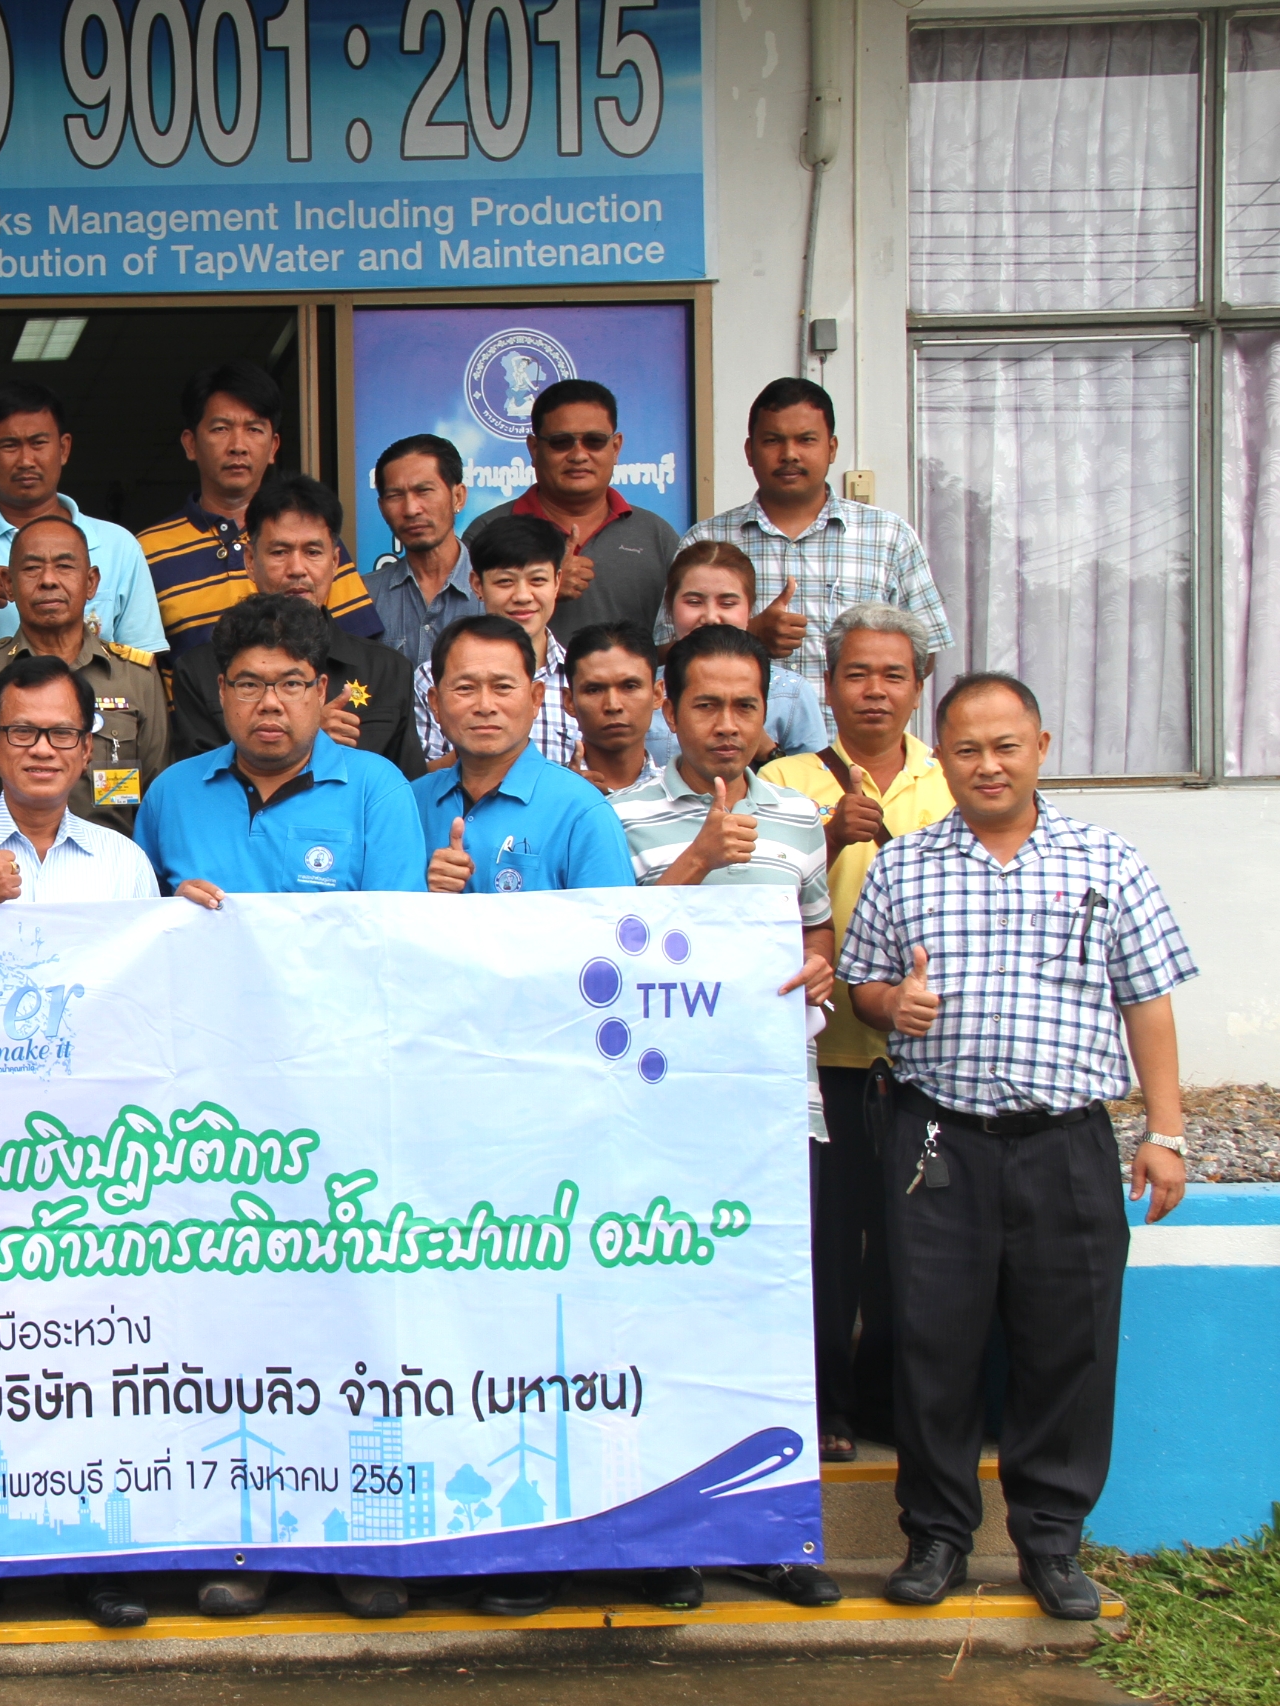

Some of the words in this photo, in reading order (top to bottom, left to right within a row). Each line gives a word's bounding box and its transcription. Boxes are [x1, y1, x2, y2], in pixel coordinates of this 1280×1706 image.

[60, 0, 312, 169] 9001
[400, 0, 664, 162] 2015
[48, 201, 278, 240] Management
[295, 199, 454, 235] Including
[471, 194, 662, 227] Production
[122, 245, 157, 275] of
[171, 243, 344, 280] TapWater
[358, 241, 422, 271] and
[440, 239, 665, 270] Maintenance
[636, 981, 722, 1019] TTW
[56, 1038, 71, 1058] it
[113, 1362, 320, 1417] ทีทีดับบลิว
[339, 1361, 454, 1417] จำกัด
[471, 1365, 643, 1421] (มหาชน)
[114, 1448, 172, 1492] วันที่
[185, 1460, 219, 1491] 17
[230, 1457, 339, 1493] สิงหาคม
[351, 1463, 417, 1495] 2561
